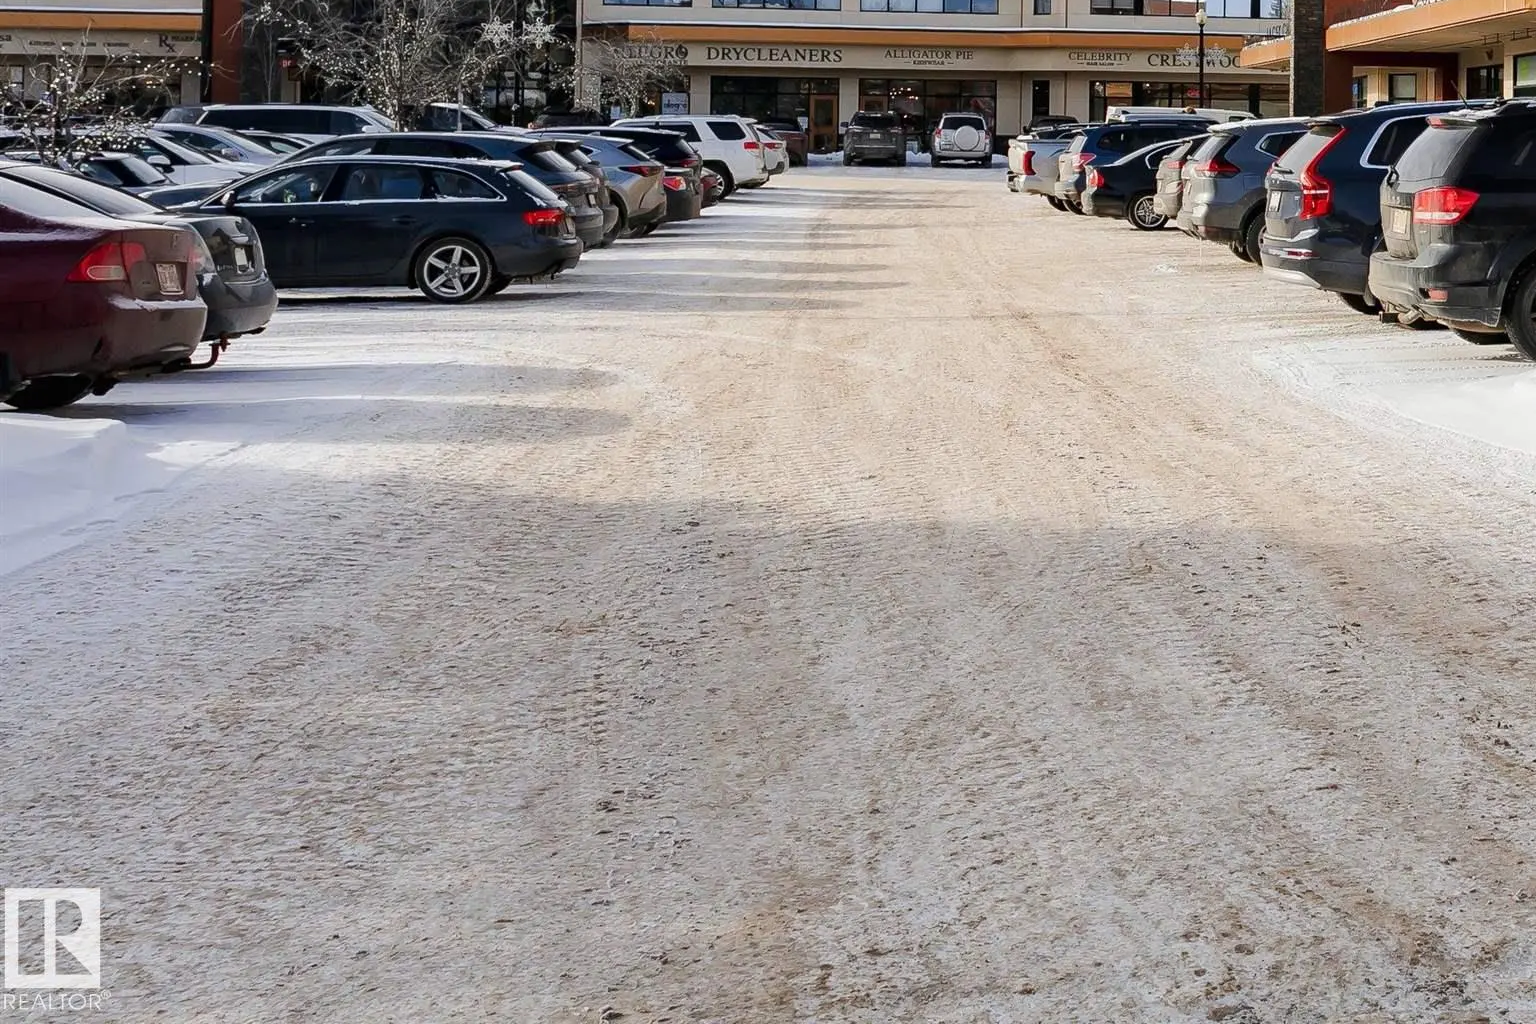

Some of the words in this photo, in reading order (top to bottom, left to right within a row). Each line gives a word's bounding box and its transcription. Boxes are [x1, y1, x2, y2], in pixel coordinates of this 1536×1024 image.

[706, 46, 843, 63] DRYCLEANERS
[884, 49, 952, 60] ALLIGATOR
[955, 50, 974, 60] PIE
[1068, 51, 1133, 62] CELEBRITY
